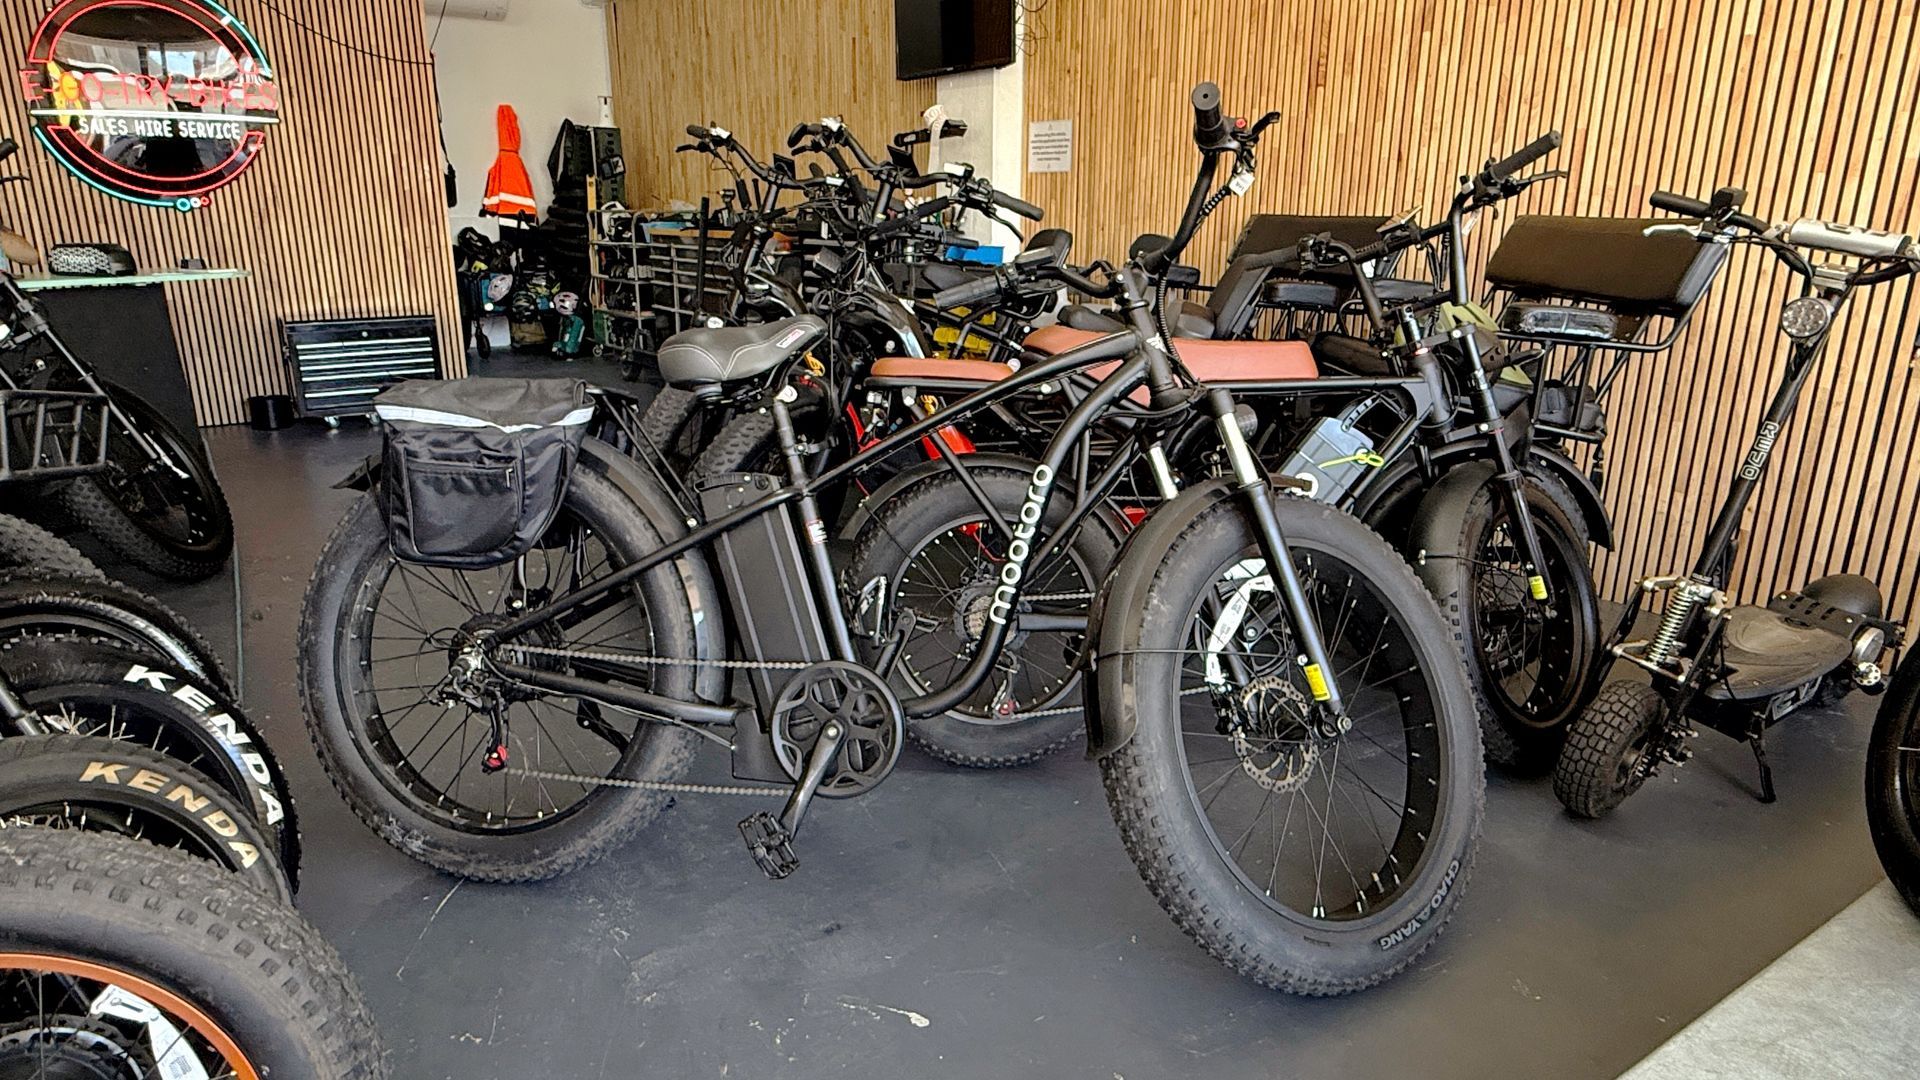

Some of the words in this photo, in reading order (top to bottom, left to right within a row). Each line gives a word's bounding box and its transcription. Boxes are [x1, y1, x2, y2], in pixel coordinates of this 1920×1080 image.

[79, 116, 128, 136] SALES
[134, 118, 173, 138] HIRE
[178, 120, 241, 140] SERVICE
[989, 464, 1053, 625] mootoro
[123, 664, 285, 826] KENDA
[79, 761, 260, 869] KENDA
[1380, 919, 1422, 950] YANG
